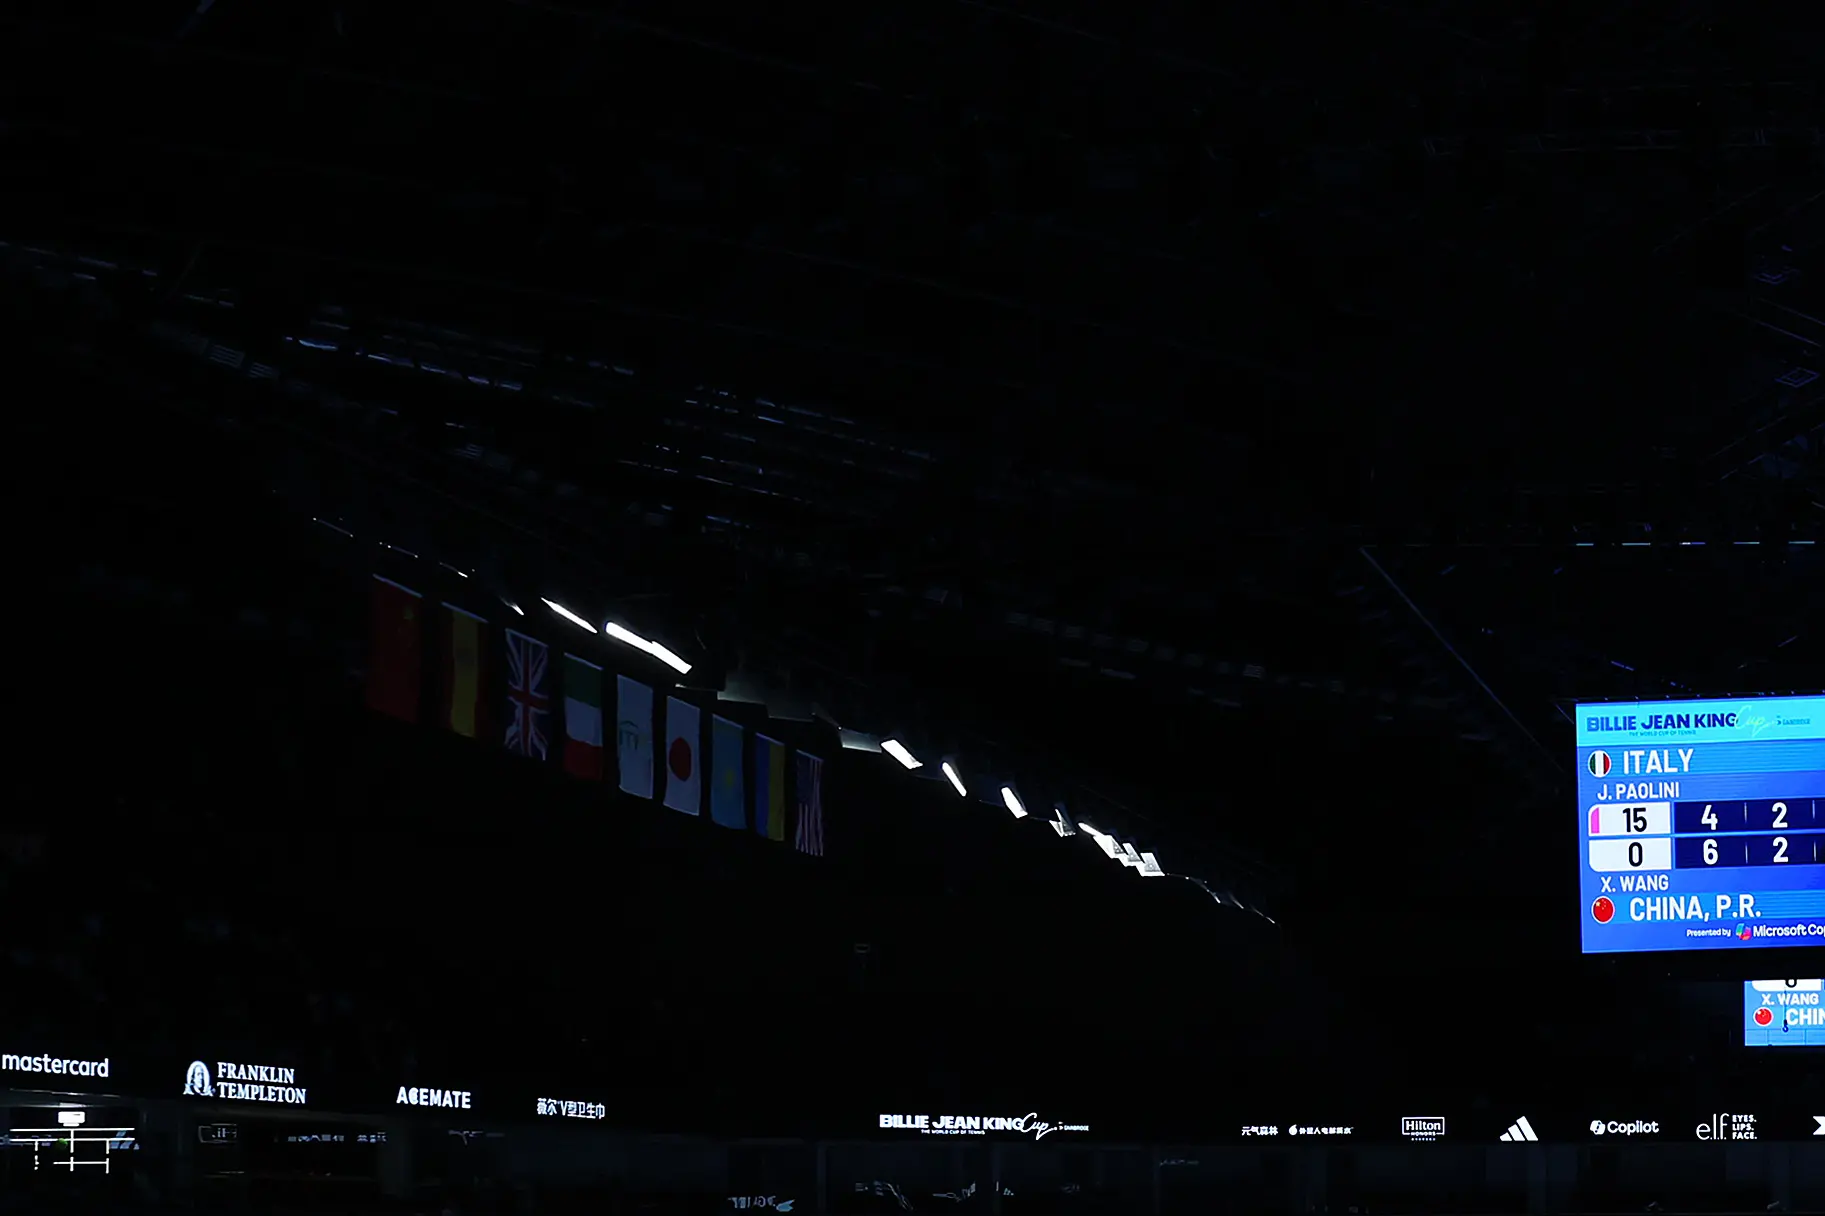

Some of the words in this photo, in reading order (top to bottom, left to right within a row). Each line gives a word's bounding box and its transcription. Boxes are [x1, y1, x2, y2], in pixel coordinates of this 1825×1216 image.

[1586, 715, 1636, 732] BILLIE
[1641, 713, 1690, 730] JEAN
[1694, 712, 1739, 729] KING
[1622, 748, 1694, 775] ITALY
[1597, 784, 1612, 801] J.
[1616, 782, 1680, 800] PAOLINI
[1622, 807, 1648, 833] 15
[1701, 804, 1719, 831] 4
[1771, 801, 1789, 829] 2
[1628, 841, 1643, 868] 0
[1702, 838, 1719, 865] 6
[1772, 836, 1789, 863] 2
[1600, 876, 1616, 893] X.
[1619, 874, 1669, 892] WANG
[1629, 895, 1710, 923] CHINA,
[1716, 894, 1762, 919] P.R.
[1686, 928, 1721, 937] Presented
[1722, 928, 1731, 938] by
[1752, 924, 1807, 938] Microsoft
[1762, 993, 1776, 1005] X.
[1779, 993, 1819, 1005] WANG
[1, 1052, 110, 1078] mastercard
[216, 1060, 295, 1085] FRANKLIN
[216, 1082, 307, 1104] TEMPLETON
[396, 1085, 472, 1110] ACEMATE
[879, 1114, 930, 1129] BILLIE
[931, 1115, 981, 1130] JEAN
[983, 1116, 1024, 1130] KING
[1020, 1112, 1057, 1140] Cup
[1405, 1120, 1441, 1131] Hilton
[1607, 1119, 1659, 1136] Copilot
[1732, 1114, 1757, 1123] EYES.
[1732, 1123, 1754, 1131] LIPS.
[1732, 1131, 1757, 1140] FACE.
